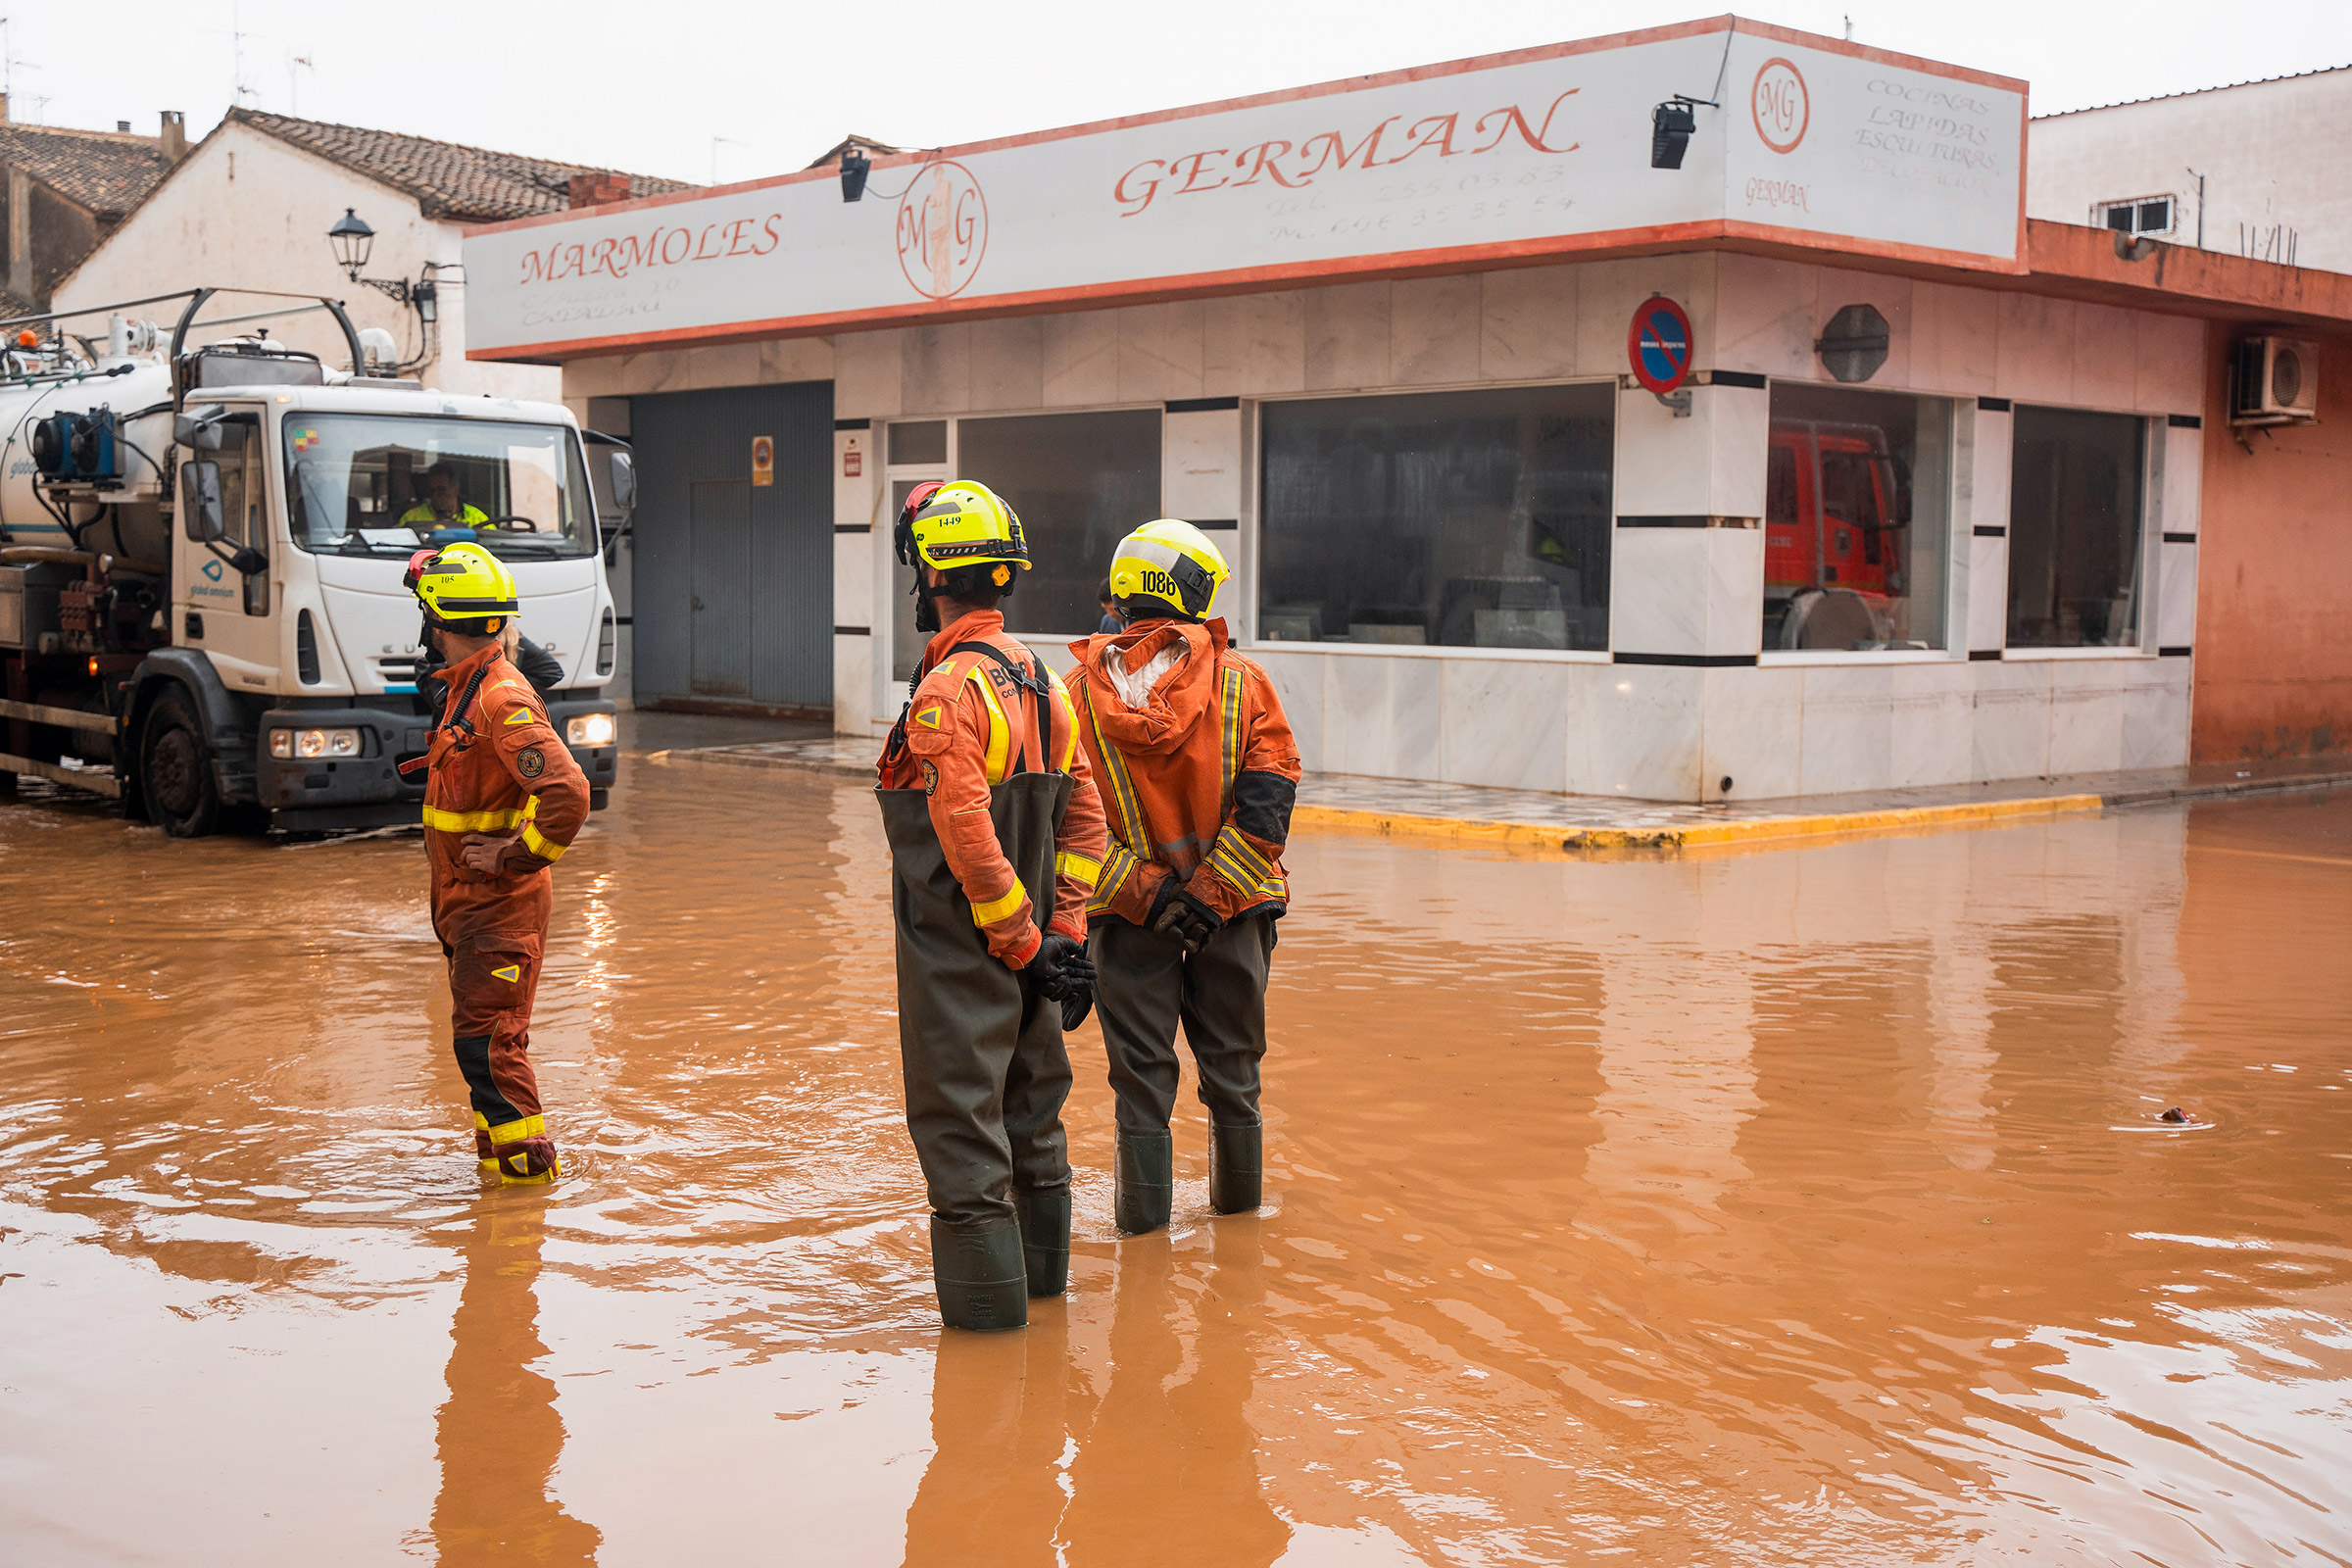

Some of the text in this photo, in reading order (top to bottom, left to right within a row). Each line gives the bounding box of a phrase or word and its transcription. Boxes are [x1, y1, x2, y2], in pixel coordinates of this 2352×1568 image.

[1760, 78, 1796, 133] MG
[1866, 78, 1991, 116] COCINAS
[1114, 87, 1582, 219] GERMAN
[1745, 176, 1811, 214] GERMAN
[519, 213, 782, 285] MARMOLES
[9, 456, 38, 479] globa
[938, 516, 961, 528] 1449
[1140, 569, 1177, 597] 1086
